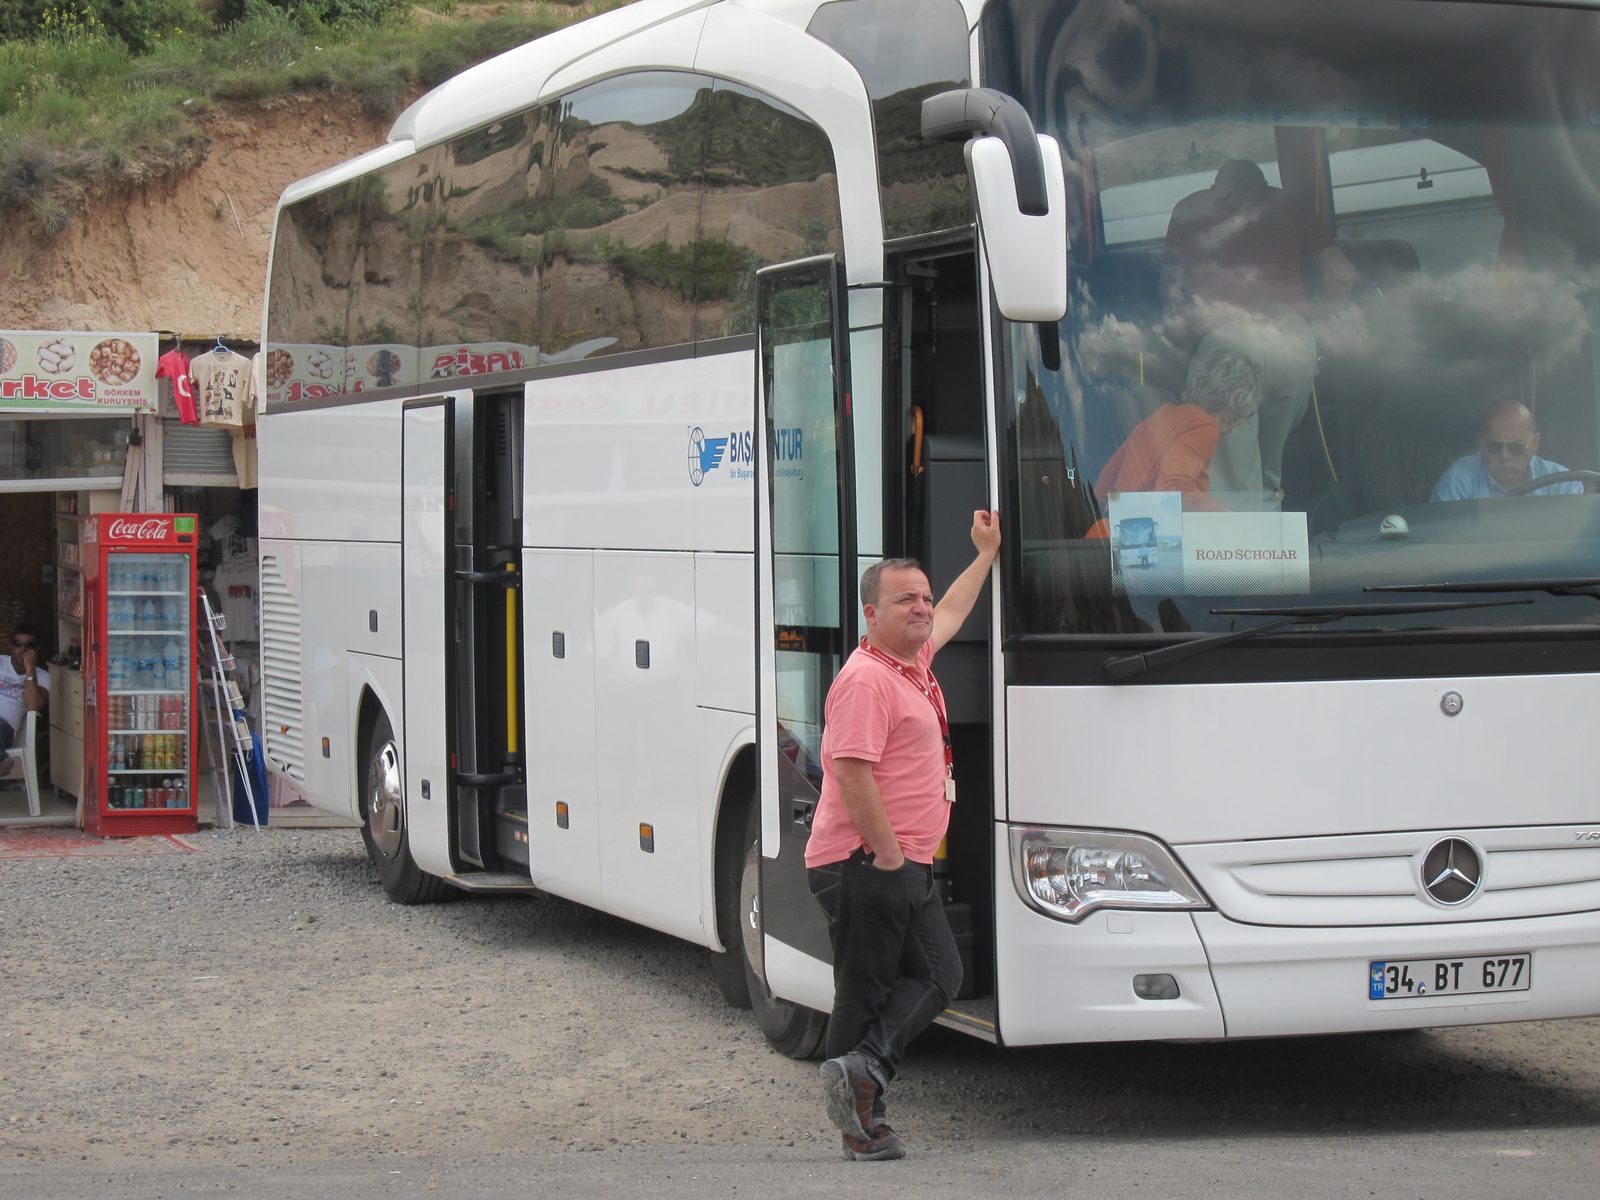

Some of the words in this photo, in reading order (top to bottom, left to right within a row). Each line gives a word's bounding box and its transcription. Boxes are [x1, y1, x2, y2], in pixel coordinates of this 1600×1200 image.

[104, 388, 141, 397] GÖRKEM
[108, 518, 170, 539] Coca-Cola
[1195, 549, 1233, 560] ROAD
[1235, 548, 1297, 560] SCHOLAR
[1385, 965, 1414, 994] 34
[1435, 962, 1463, 991] BT
[1482, 958, 1525, 988] 677
[1373, 982, 1384, 992] TR
